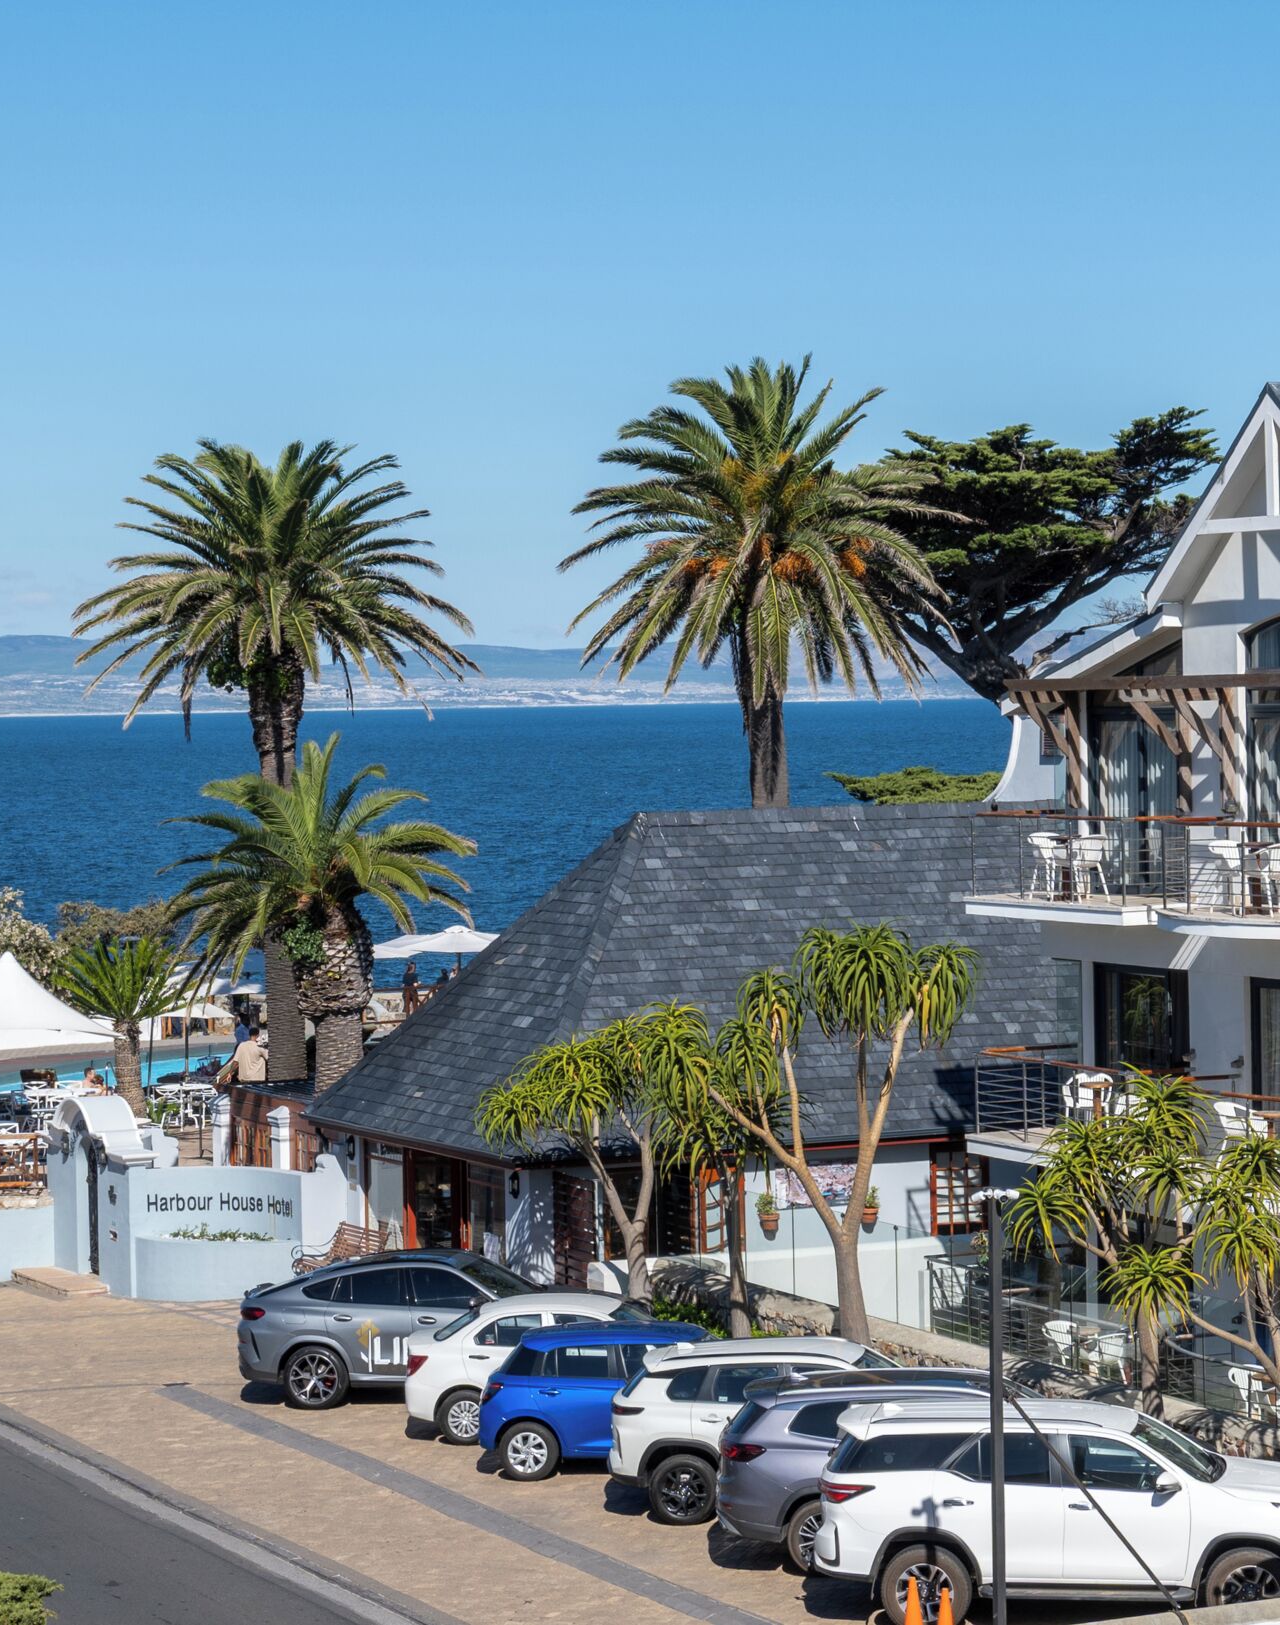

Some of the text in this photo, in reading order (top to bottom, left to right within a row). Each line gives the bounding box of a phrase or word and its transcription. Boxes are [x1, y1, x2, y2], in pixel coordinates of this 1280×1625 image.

[147, 1192, 294, 1219] Harbour House Hotel
